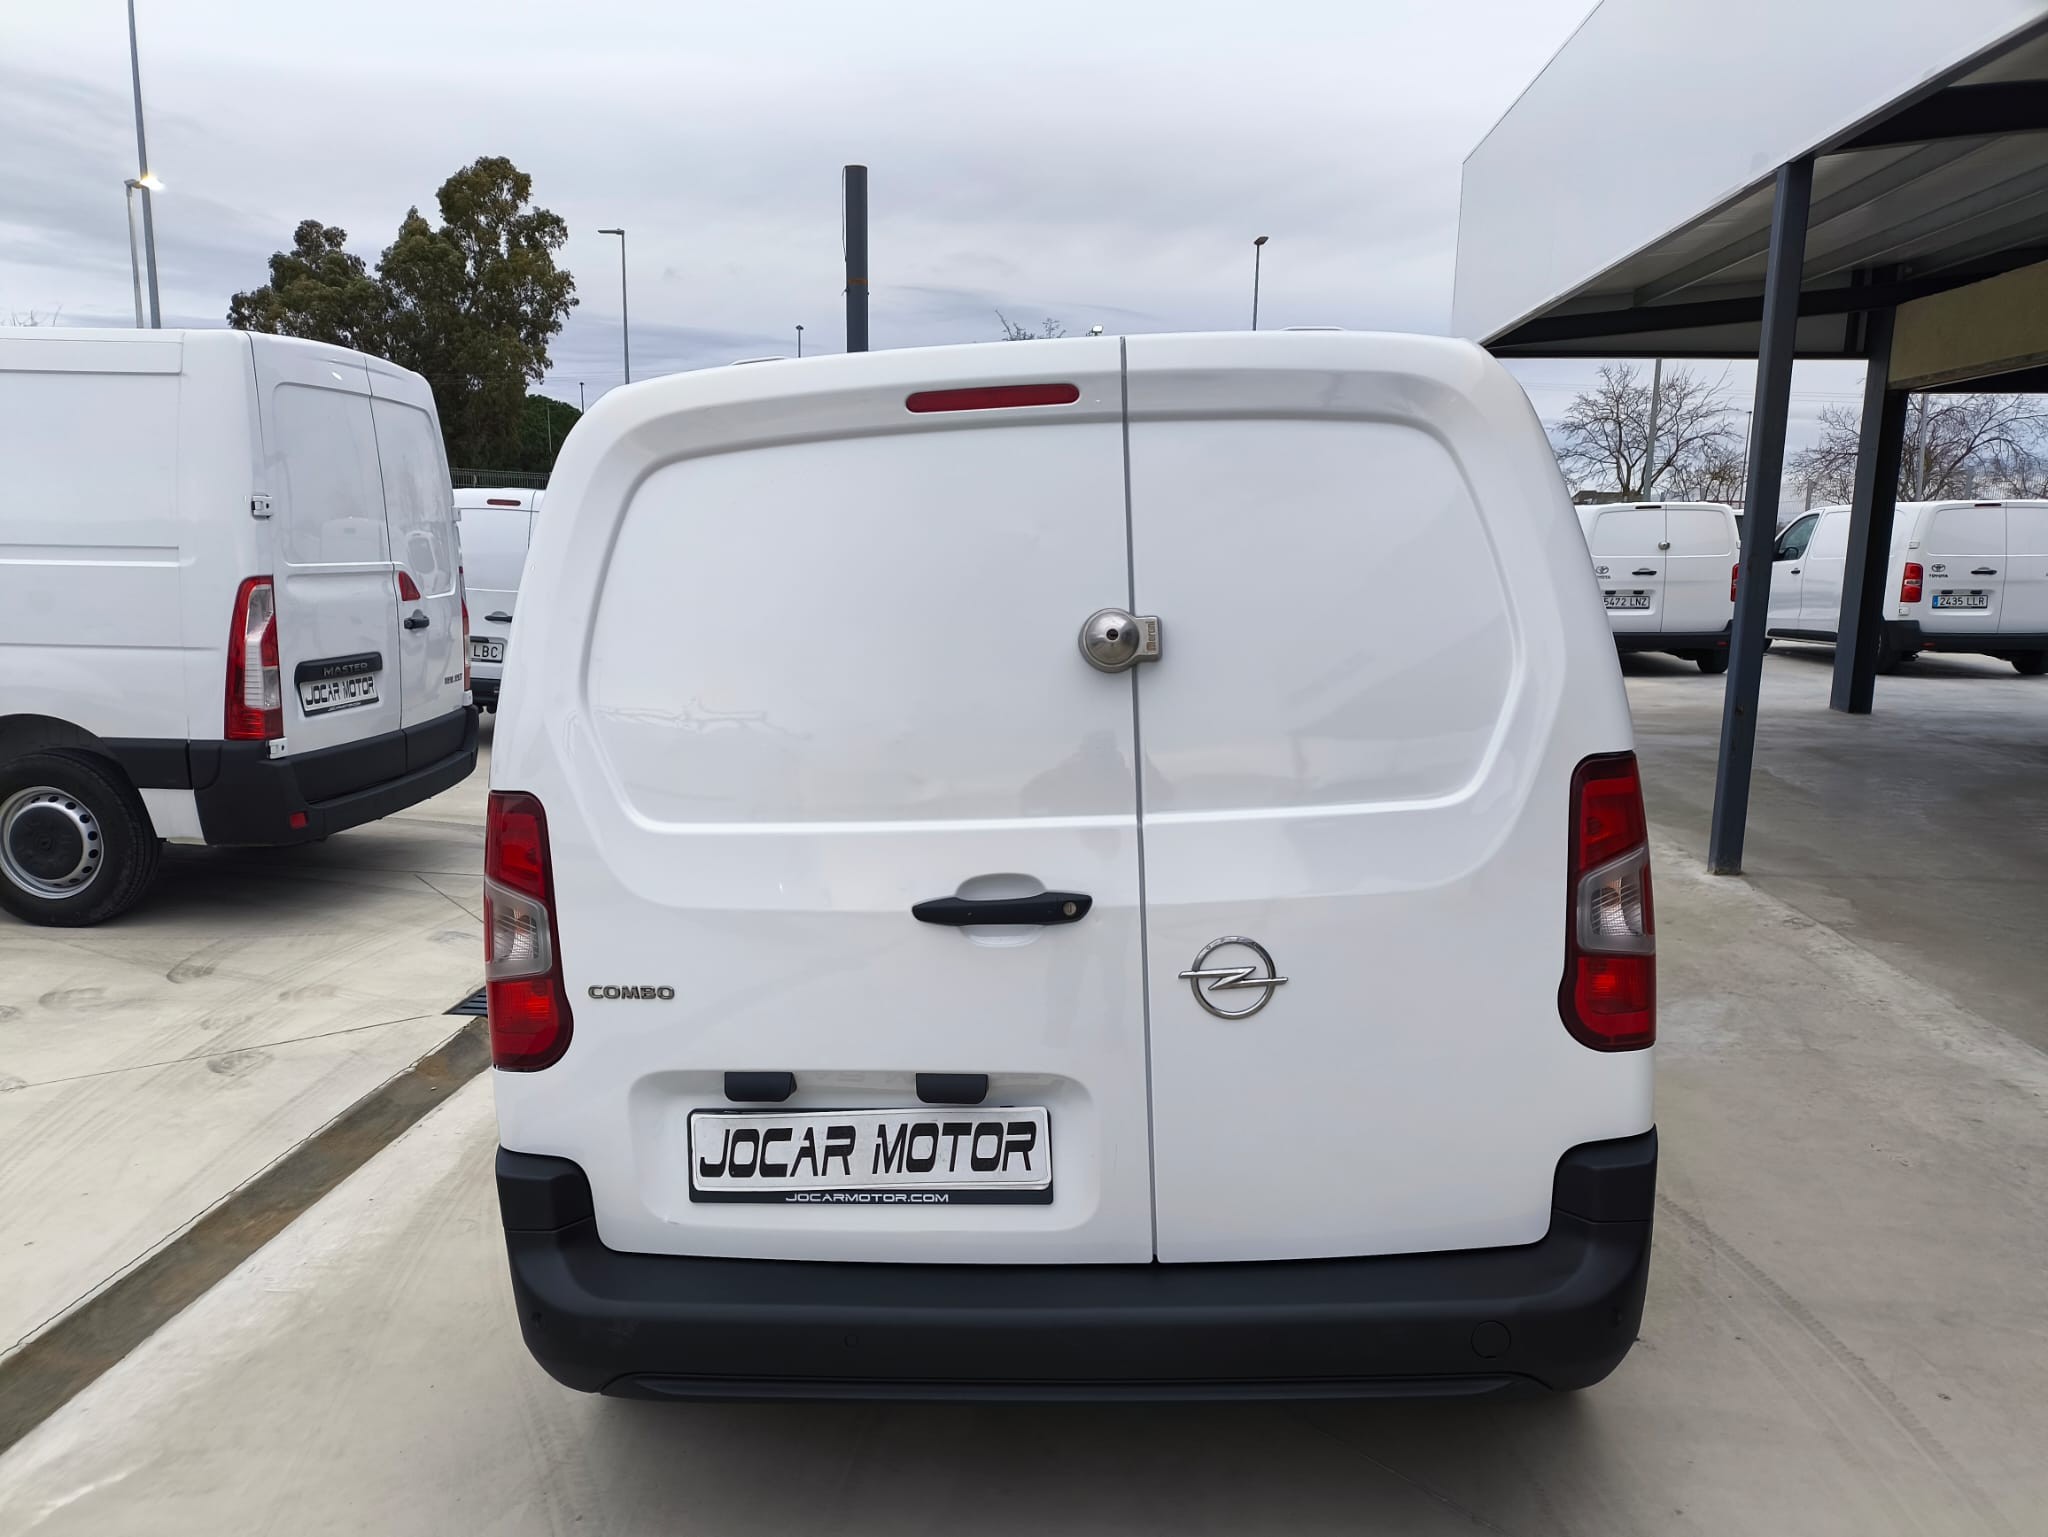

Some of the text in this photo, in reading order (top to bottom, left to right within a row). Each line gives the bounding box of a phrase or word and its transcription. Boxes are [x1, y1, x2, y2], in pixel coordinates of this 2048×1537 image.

[1603, 597, 1647, 606] 5472 LNZ
[1940, 597, 1984, 606] 2435 LLR
[473, 645, 498, 658] LBC
[323, 662, 368, 677] MASTER
[305, 676, 374, 706] JOCAR MOTOR
[588, 985, 675, 1000] COMBO
[699, 1121, 1037, 1178] JOCAR MOTOR
[785, 1193, 949, 1202] JOCARMOTOR.COM
